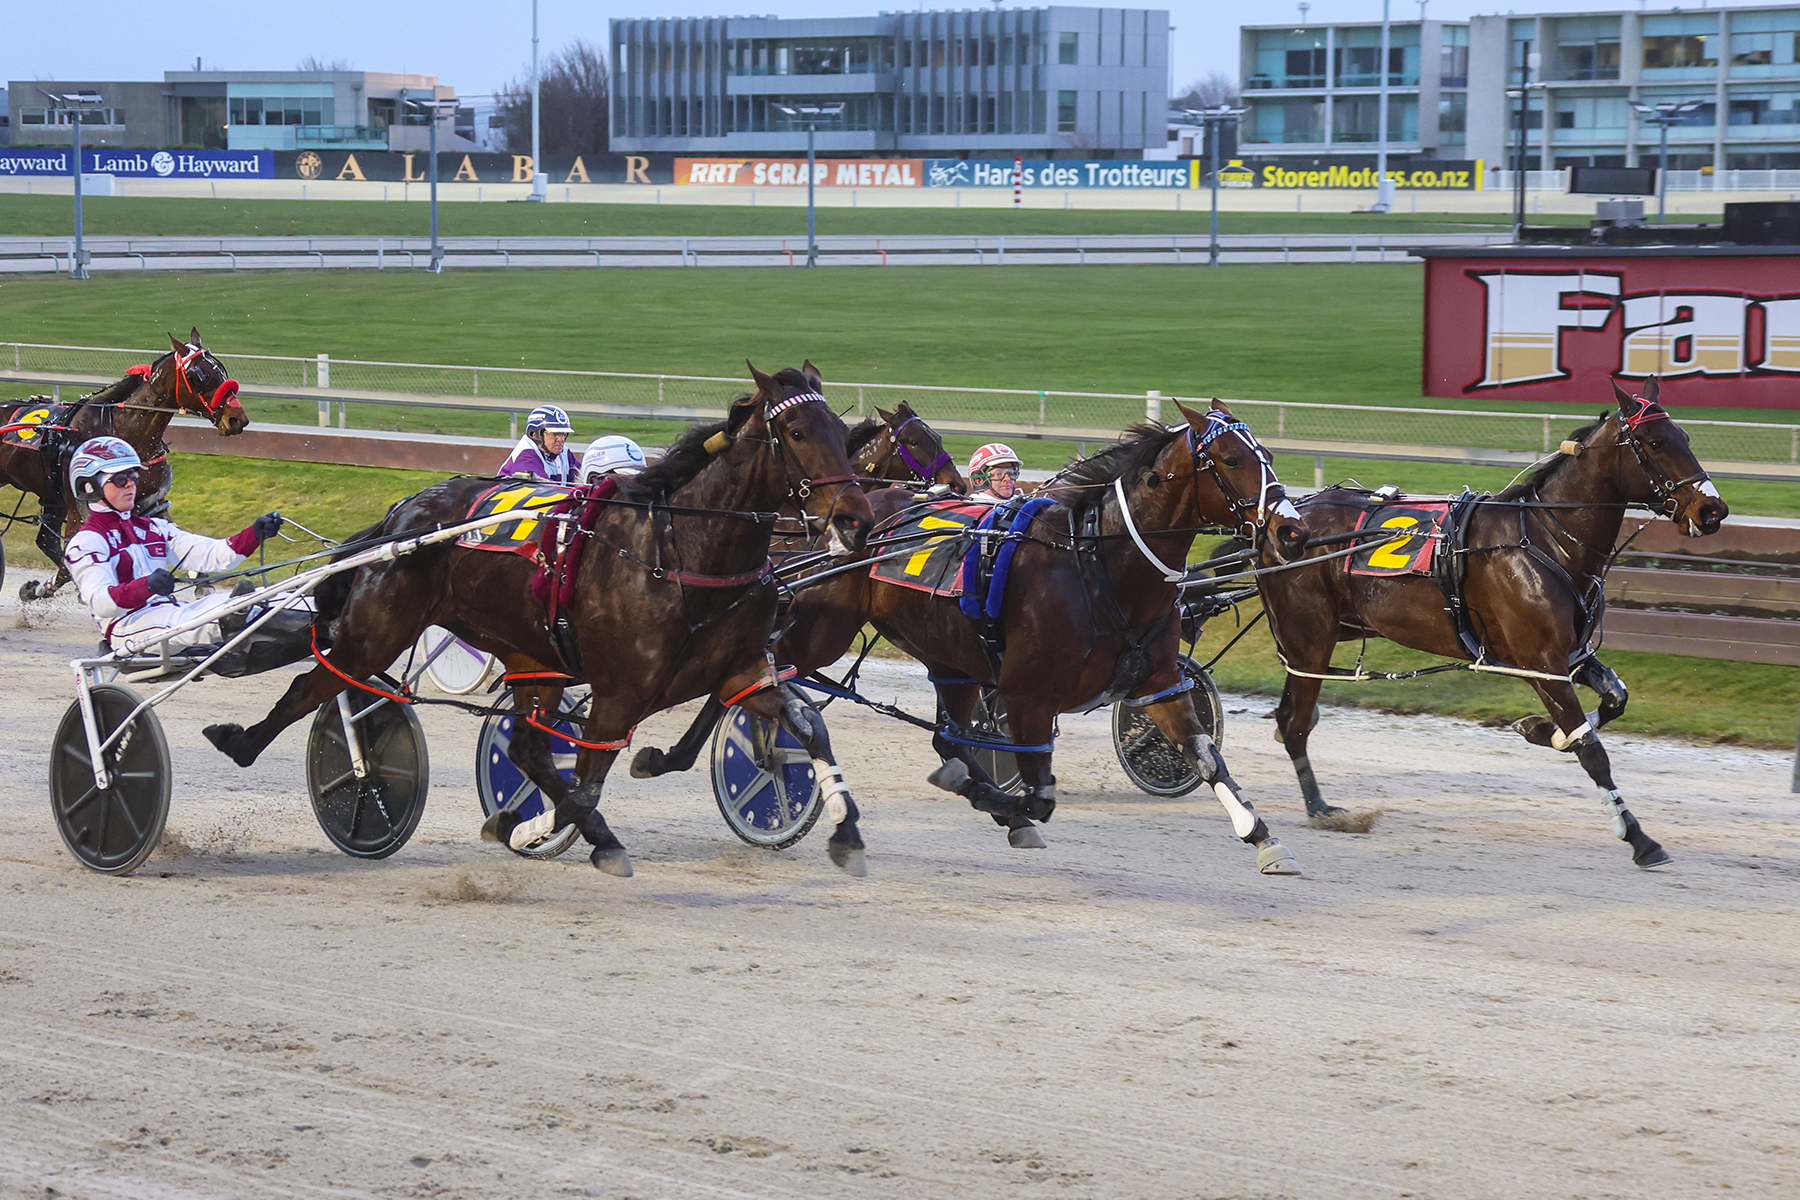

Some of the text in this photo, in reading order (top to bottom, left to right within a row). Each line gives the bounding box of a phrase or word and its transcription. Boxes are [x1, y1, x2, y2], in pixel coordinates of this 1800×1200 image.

[0, 153, 67, 174] ayward
[93, 154, 148, 172] Lamb
[178, 155, 260, 176] Hayward
[690, 162, 916, 186] RRT SCRAP METAL
[1040, 163, 1079, 186] des
[1085, 163, 1187, 187] Trotteurs
[17, 408, 50, 440] 6
[1367, 516, 1419, 569] 2
